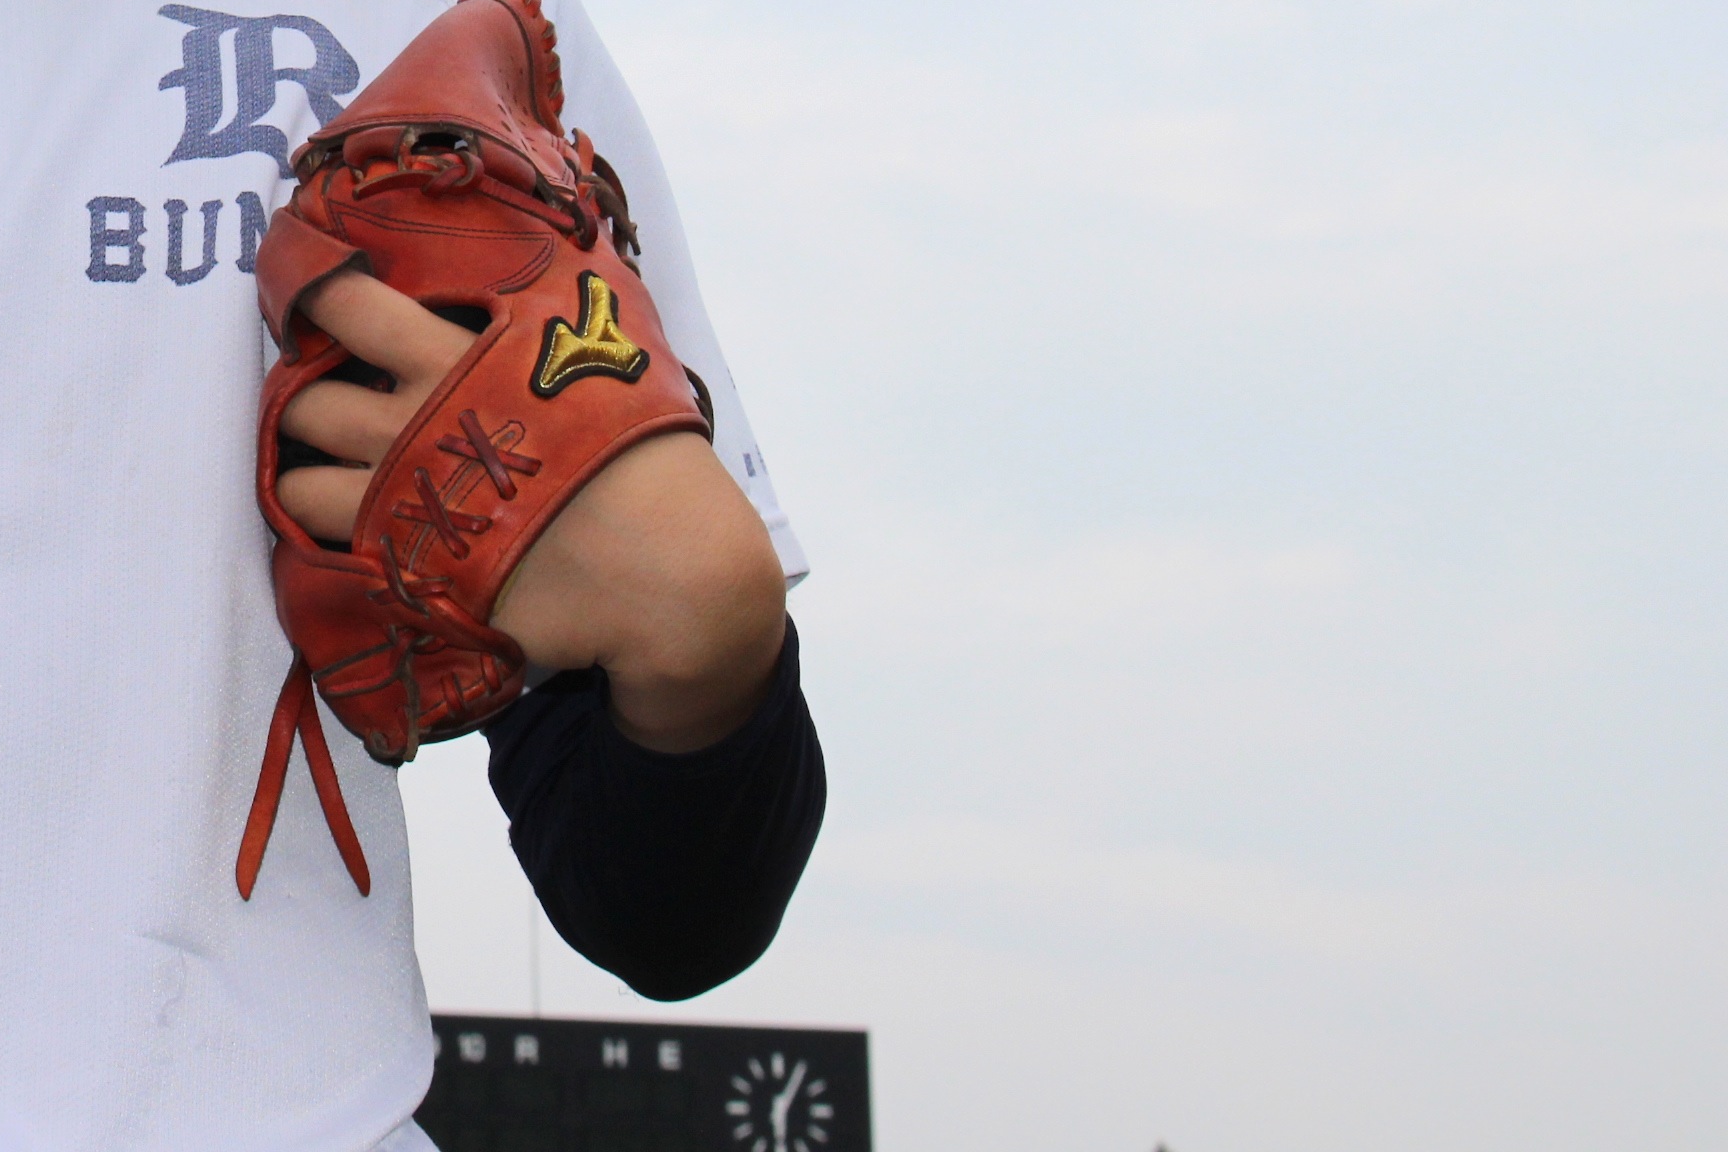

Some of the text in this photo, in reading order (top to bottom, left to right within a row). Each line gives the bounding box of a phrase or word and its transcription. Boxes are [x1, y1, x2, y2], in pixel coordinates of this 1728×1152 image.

[157, 3, 361, 180] R
[514, 1033, 540, 1065] R
[602, 1037, 628, 1069] H
[658, 1039, 682, 1072] E
